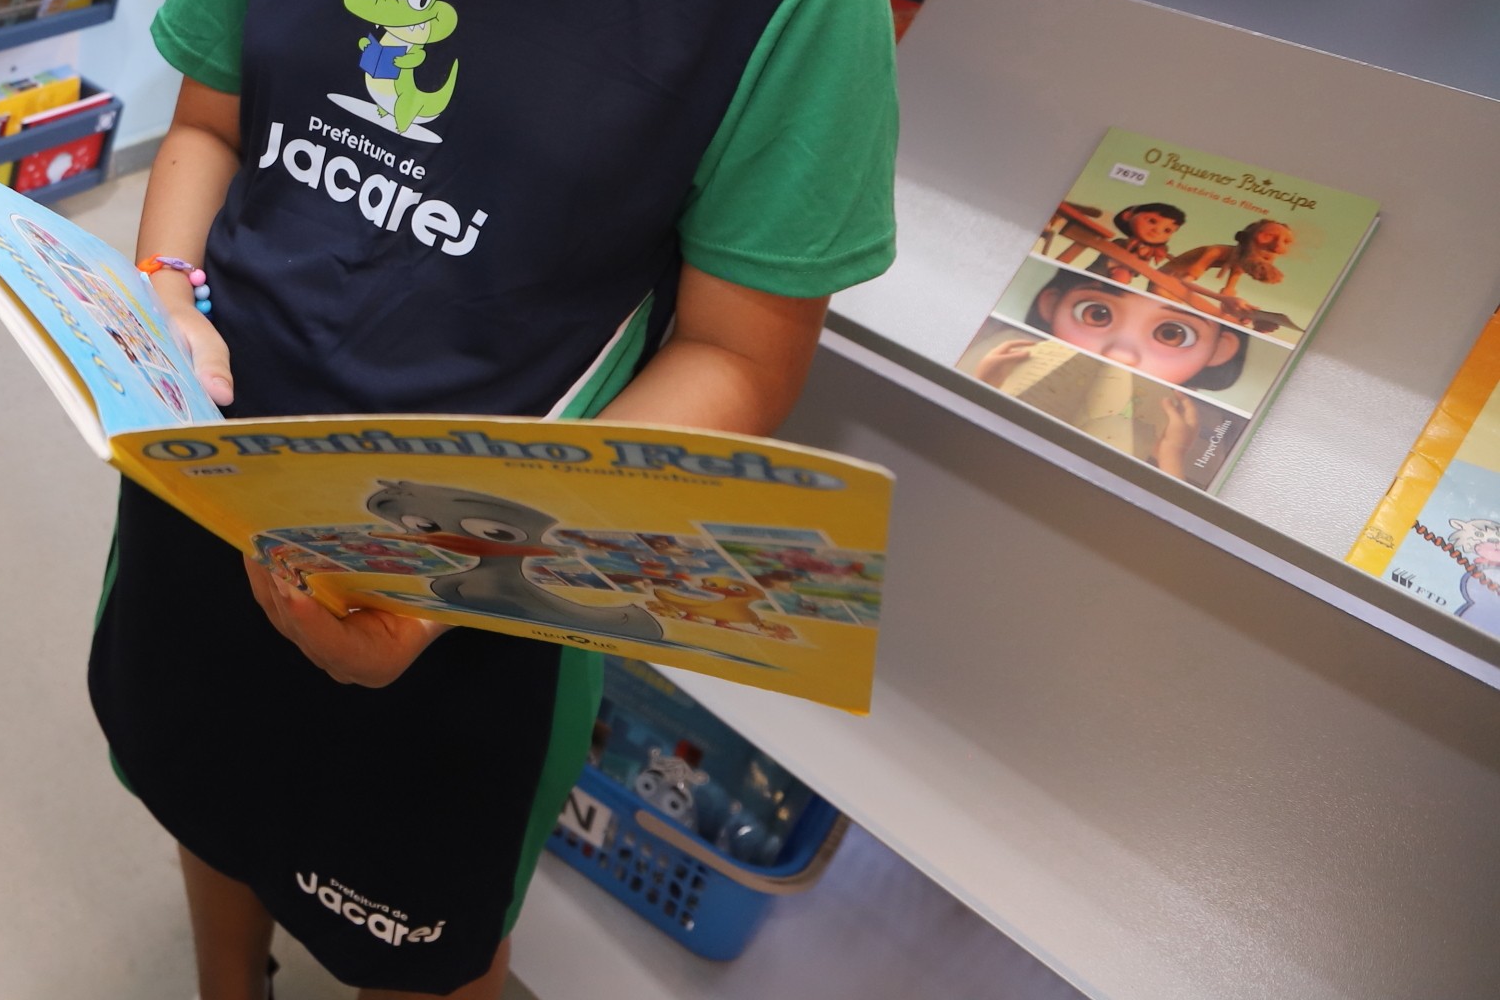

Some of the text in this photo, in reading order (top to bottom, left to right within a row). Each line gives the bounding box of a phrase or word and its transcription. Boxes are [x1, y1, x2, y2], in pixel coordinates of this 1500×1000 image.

[308, 116, 426, 180] Prefeitura de
[1143, 148, 1162, 165] O
[1161, 152, 1236, 185] Pequeno
[1165, 179, 1269, 215] A história do filme
[142, 430, 848, 491] O Patinho Feio
[1194, 420, 1232, 468] HarperCollins
[1415, 586, 1447, 606] FTD
[330, 878, 409, 922] Prefeitura de
